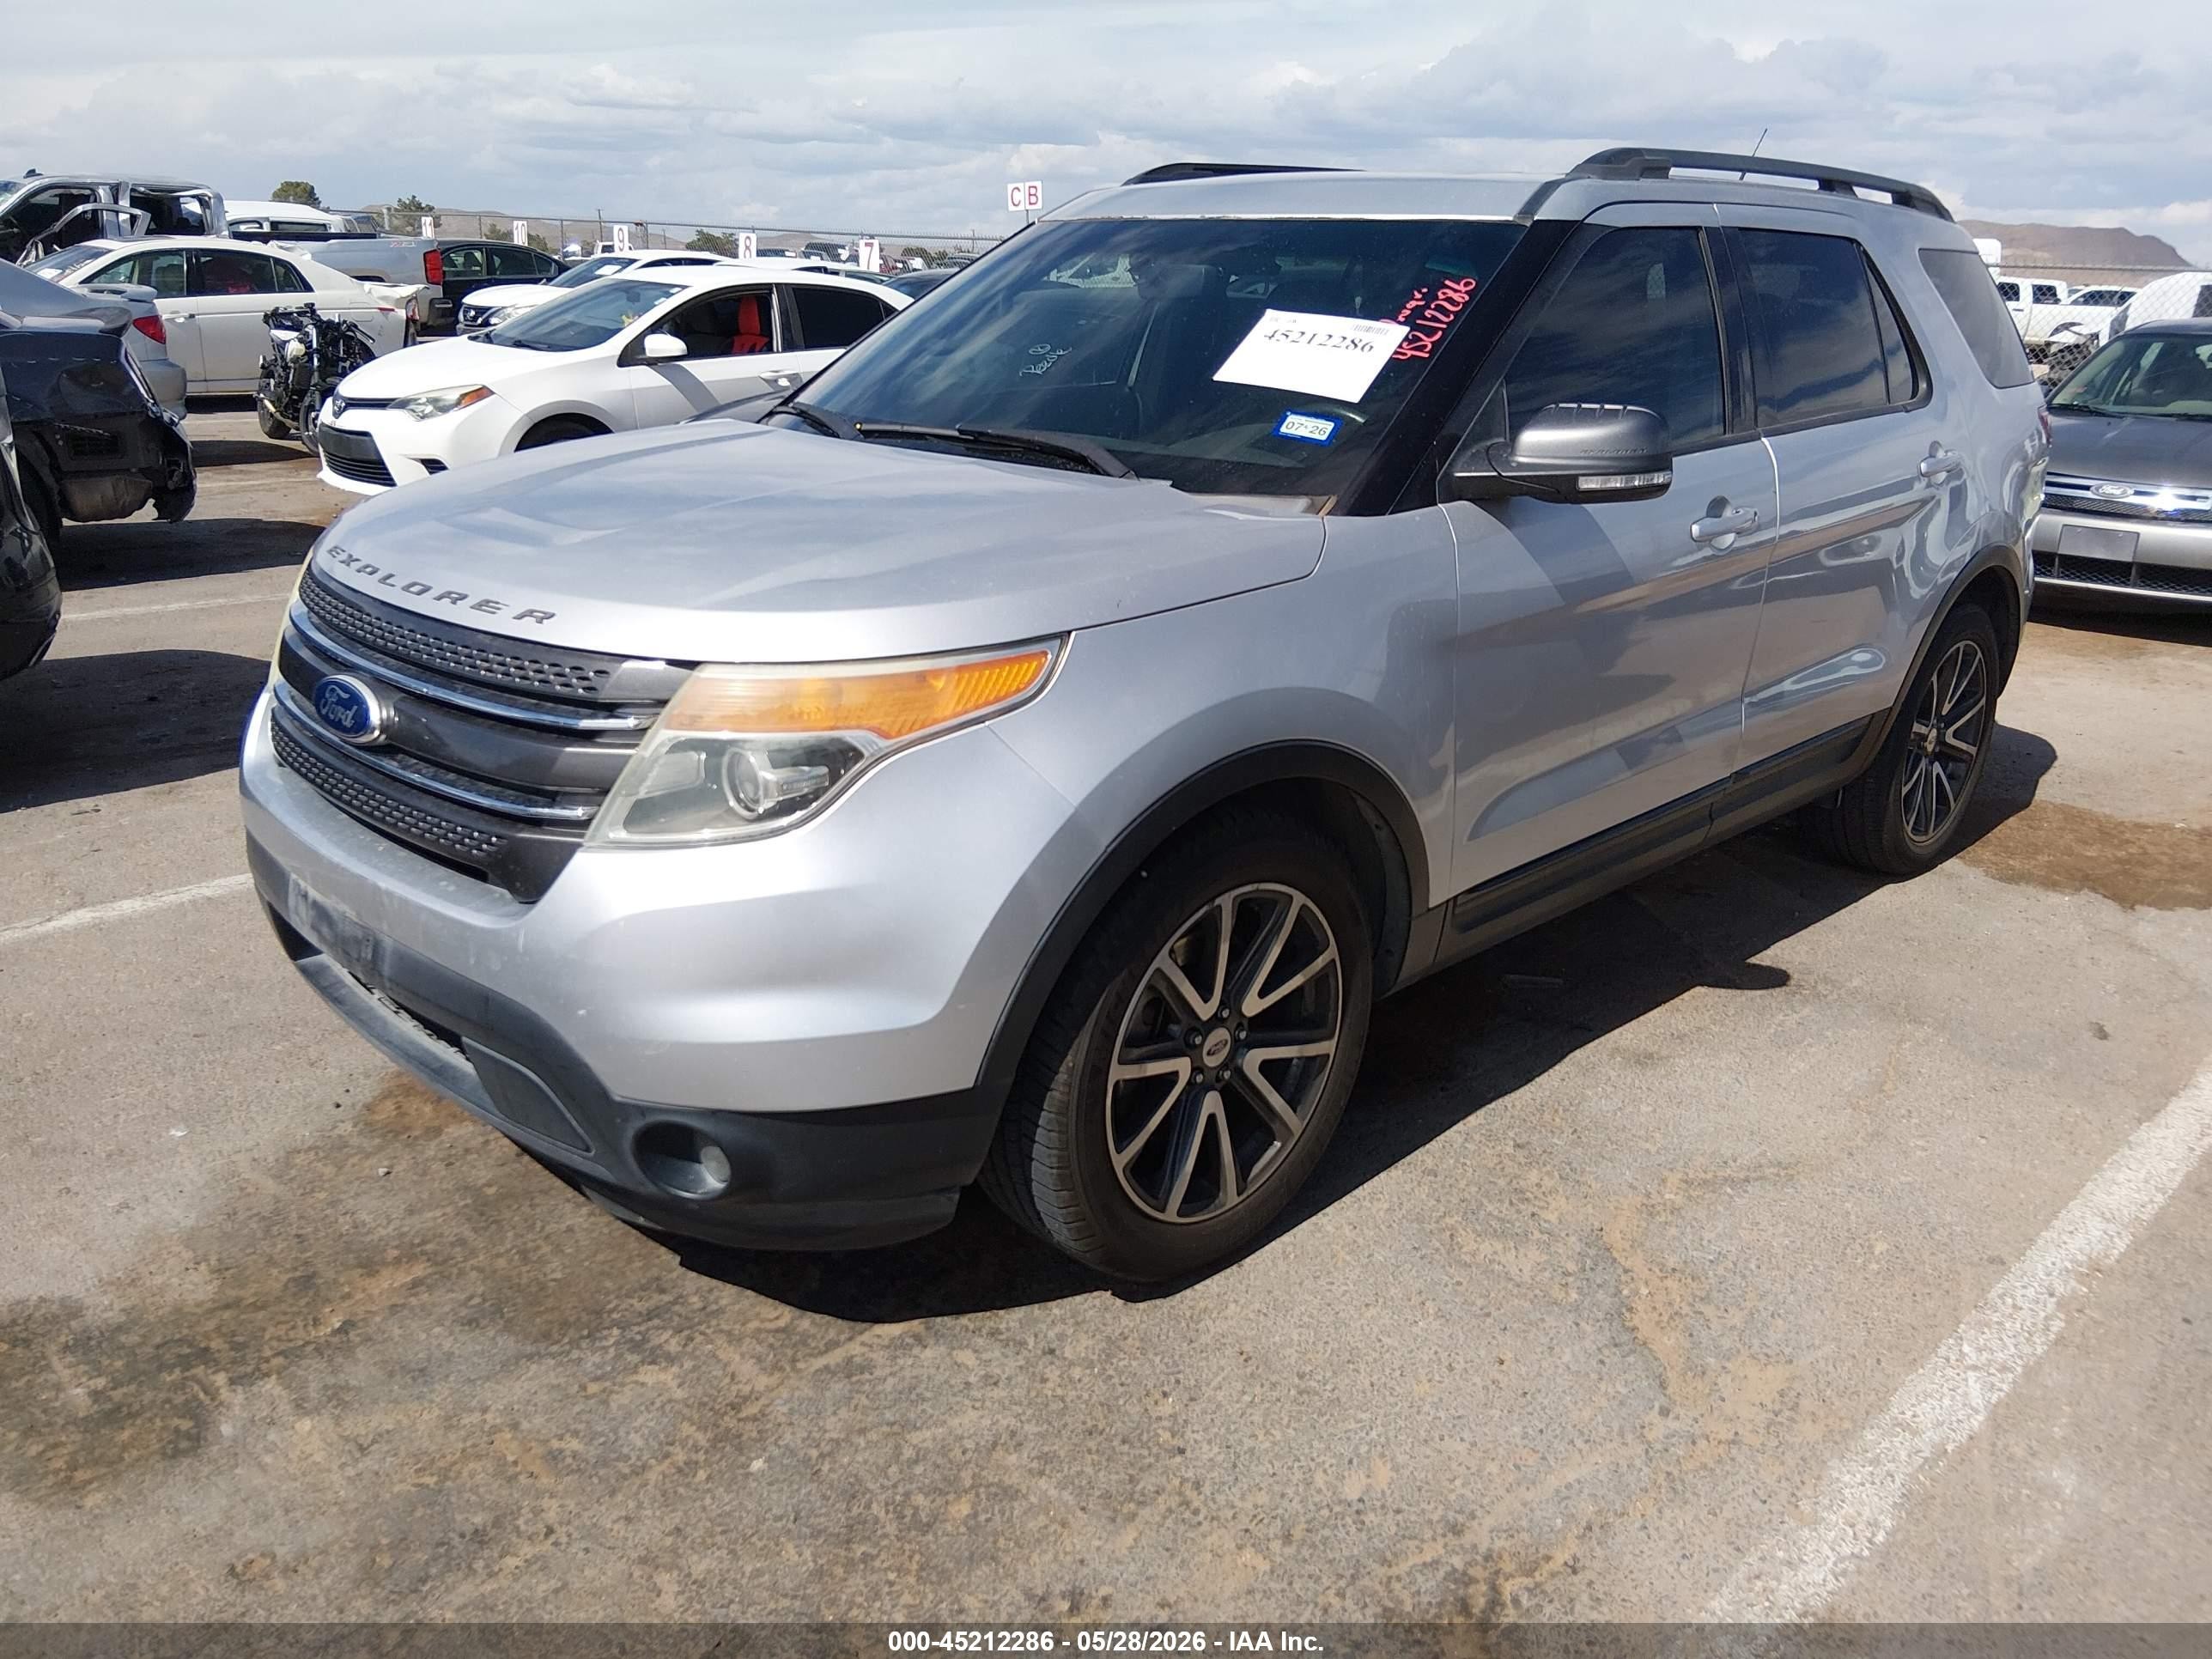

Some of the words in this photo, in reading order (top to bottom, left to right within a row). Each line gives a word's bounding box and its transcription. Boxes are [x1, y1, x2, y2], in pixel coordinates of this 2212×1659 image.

[1011, 186, 1022, 207] C
[1028, 185, 1039, 205] B
[422, 218, 434, 238] 11
[514, 222, 526, 245] 10
[617, 227, 625, 252] 9
[743, 235, 752, 258] 8
[864, 242, 874, 270] 7
[1392, 277, 1477, 360] 45212286
[1264, 328, 1374, 353] 45212286
[1285, 421, 1304, 431] 07
[1309, 425, 1329, 436] 26
[325, 545, 557, 624] EXPLORER
[319, 685, 359, 729] Ford
